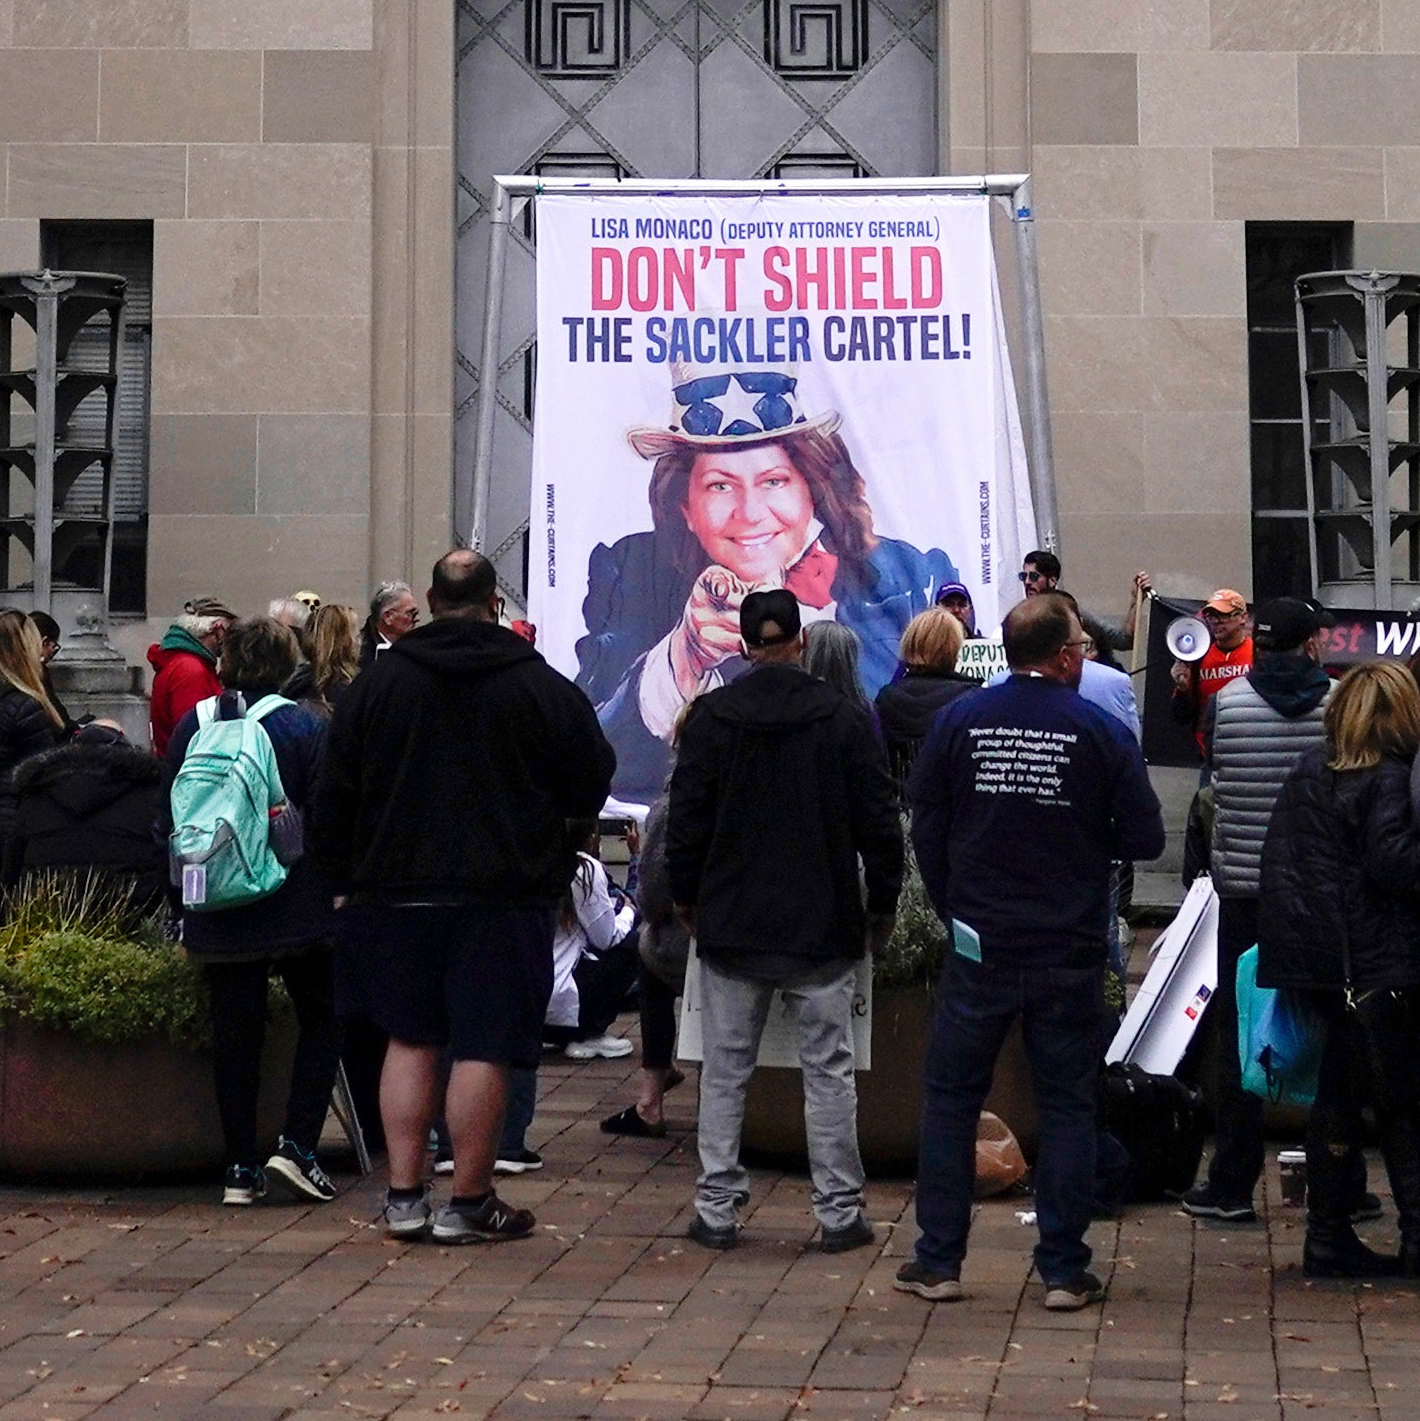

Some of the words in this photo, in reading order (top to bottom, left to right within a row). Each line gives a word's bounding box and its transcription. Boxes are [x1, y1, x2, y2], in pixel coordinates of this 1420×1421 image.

[591, 218, 630, 239] LISA
[635, 218, 713, 240] MONACO
[719, 217, 784, 245] (DEPUTY
[788, 221, 864, 239] ATTORNEY
[868, 216, 942, 242] GENERAL)
[590, 245, 746, 312] DON'T
[762, 245, 943, 312] SHIELD
[562, 317, 633, 363] THE
[645, 317, 813, 364] SACKLER
[823, 313, 972, 363] CARTEL!
[1024, 729, 1043, 739] that
[1004, 738, 1014, 747] of
[1053, 754, 1070, 764] can
[980, 761, 1012, 772] change
[1013, 761, 1028, 771] the
[1026, 774, 1040, 784] the
[1041, 776, 1063, 788] only
[975, 783, 998, 794] thing
[999, 784, 1016, 793] that
[1017, 786, 1037, 794] ever
